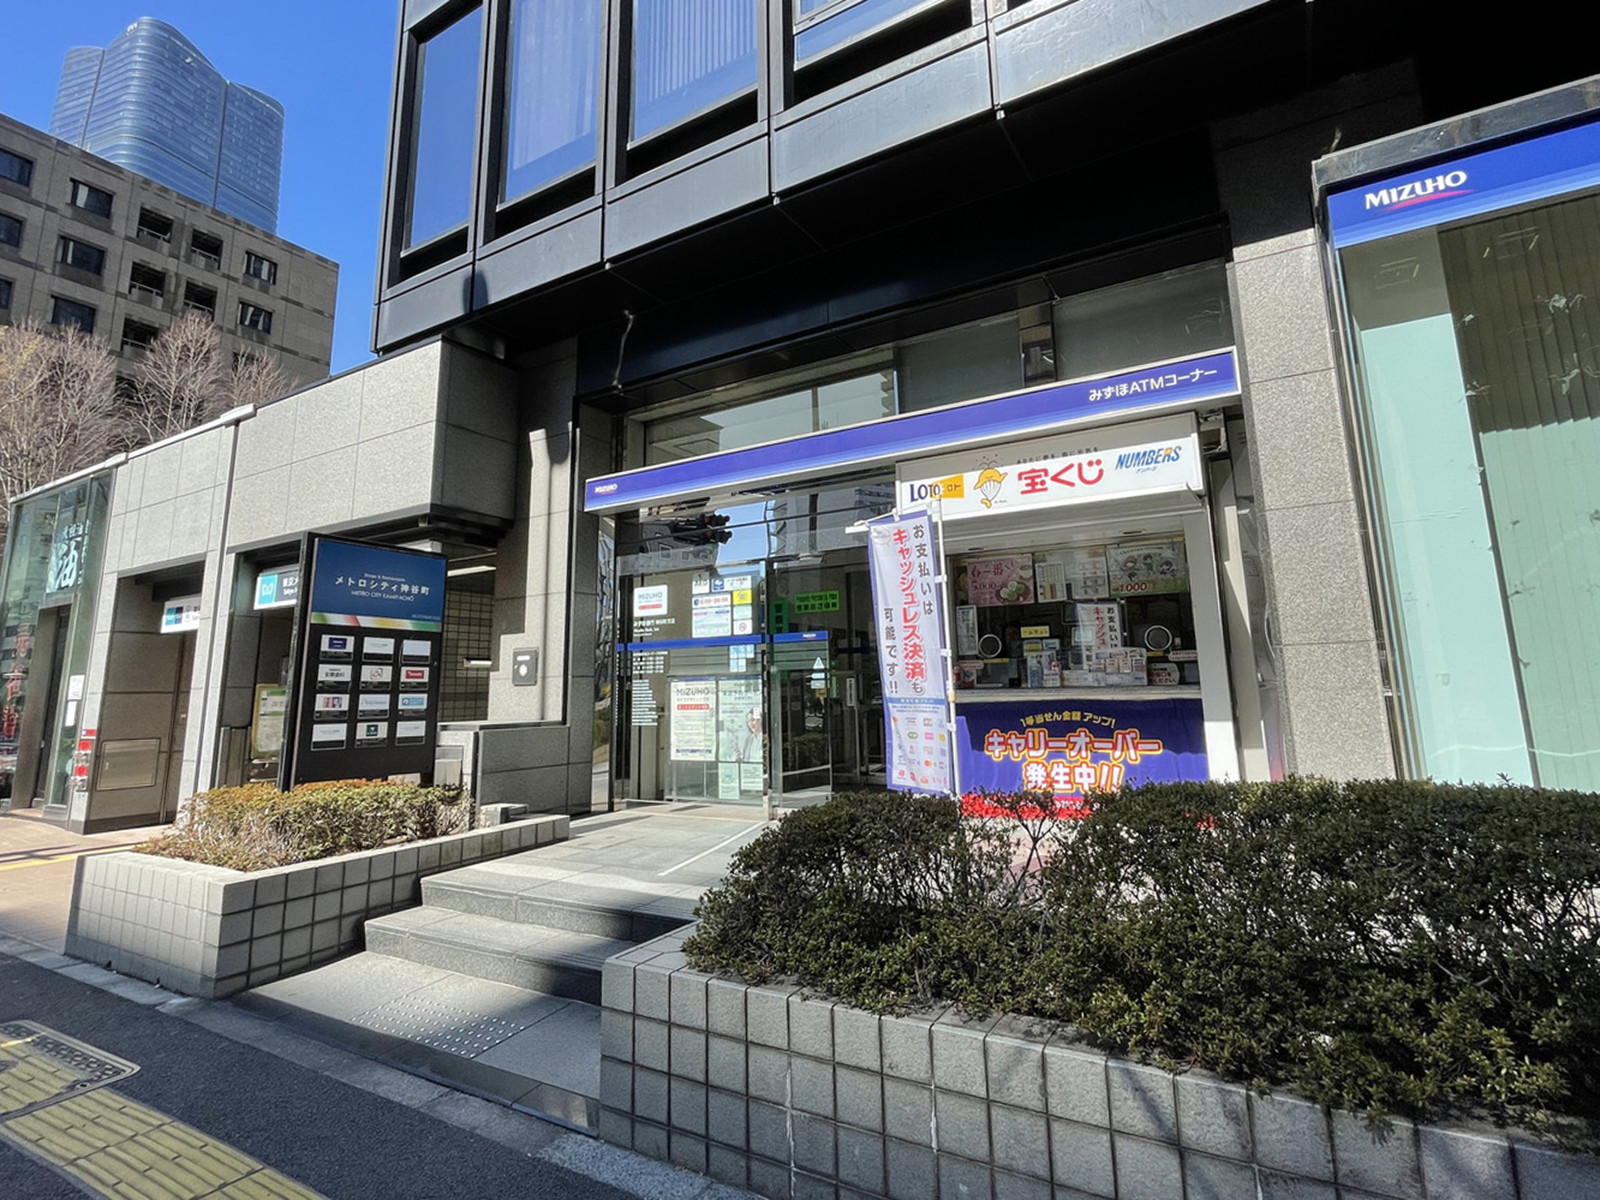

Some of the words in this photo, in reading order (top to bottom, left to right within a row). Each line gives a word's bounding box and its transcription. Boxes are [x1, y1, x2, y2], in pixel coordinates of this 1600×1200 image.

[1364, 170, 1468, 210] MIZUHO
[1088, 368, 1218, 402] みずほATMコーナー
[1115, 445, 1182, 470] NUMBERS
[909, 483, 941, 503] LOTO
[1018, 458, 1104, 495] 宝くじ
[335, 576, 430, 596] メトロシティ神谷町
[912, 524, 934, 616] お支払いは
[892, 528, 925, 694] キャッシュレス決済も
[884, 607, 899, 694] 可能です!!
[676, 686, 710, 696] MIZUHO
[985, 728, 1162, 762] キャリーオーバー
